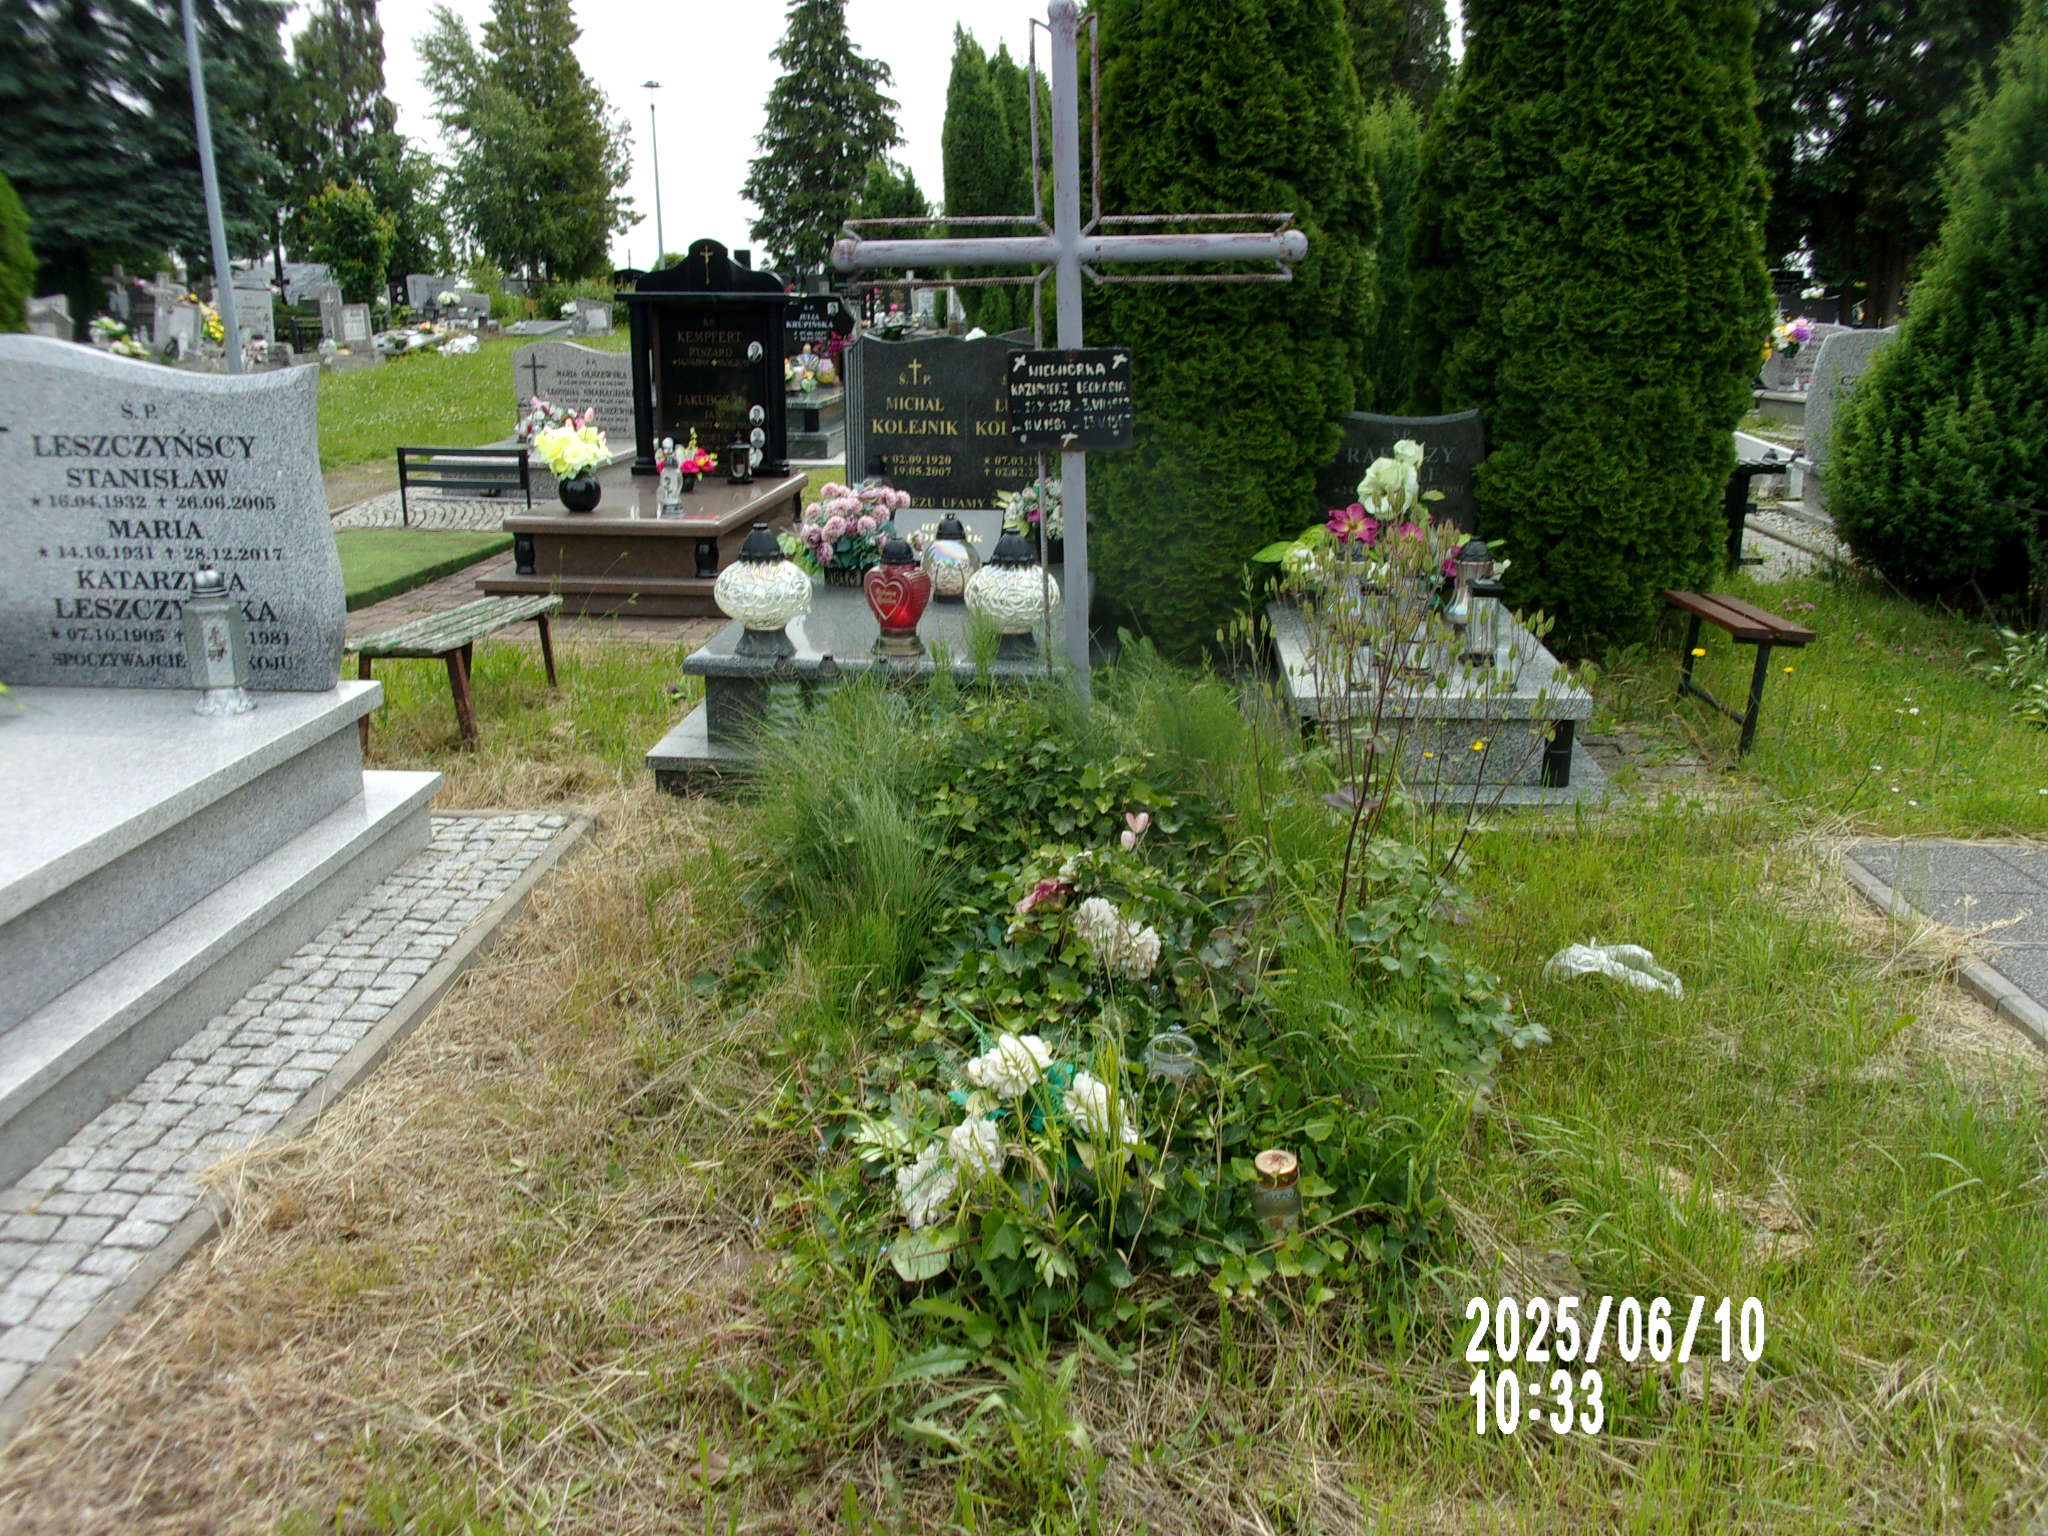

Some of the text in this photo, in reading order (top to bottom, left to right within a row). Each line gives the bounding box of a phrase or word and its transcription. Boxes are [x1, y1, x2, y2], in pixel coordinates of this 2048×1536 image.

[872, 418, 960, 436] KOLEJNIK
[32, 428, 256, 459] LESZCZYŃSCY
[1347, 447, 1456, 463] RAKZY
[66, 468, 229, 490] STANISŁAW
[911, 496, 936, 508] EZU
[108, 519, 205, 540] MARIA
[183, 547, 283, 562] 28.12.2017
[77, 568, 248, 593] KATARZA
[55, 598, 279, 623] LESZCZYKA
[51, 652, 187, 669] SPOCZYWAJCIE
